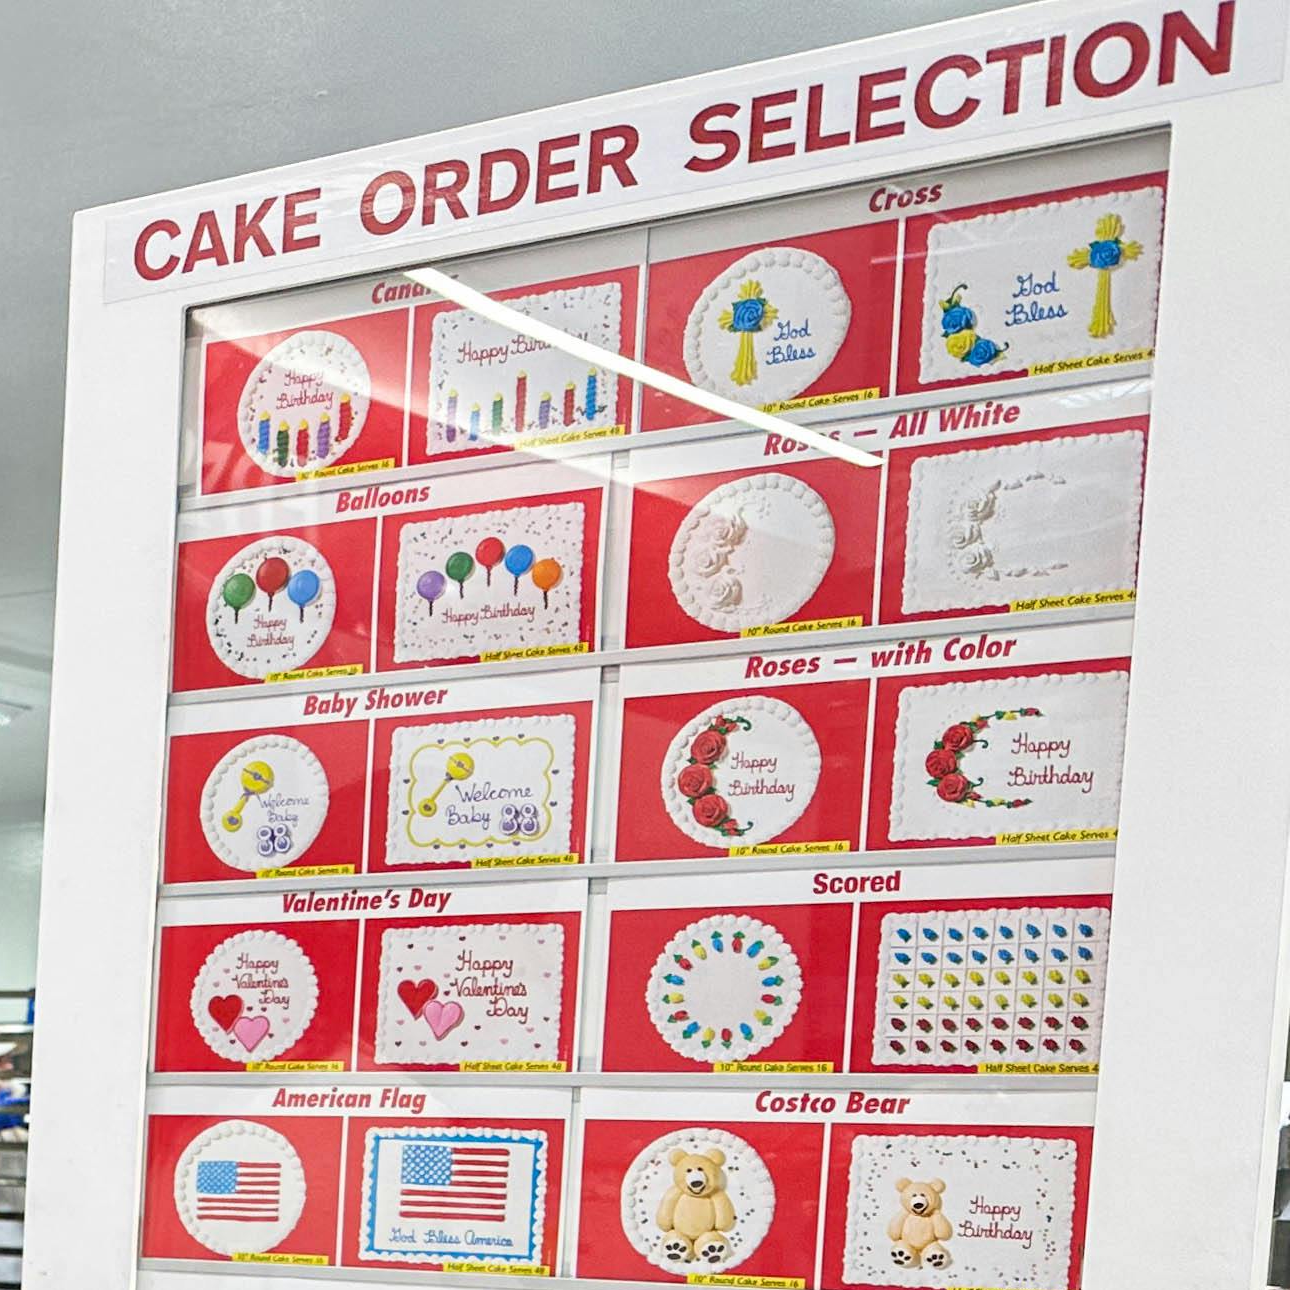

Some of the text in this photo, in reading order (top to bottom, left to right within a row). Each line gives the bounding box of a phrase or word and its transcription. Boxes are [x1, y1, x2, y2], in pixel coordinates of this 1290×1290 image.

[133, 0, 1236, 282] CAKE ORDER SELECTION
[869, 182, 943, 214] Cross
[1011, 273, 1061, 298] God
[1004, 301, 1068, 328] Bless
[772, 320, 811, 342] God
[457, 339, 509, 366] Happy
[765, 343, 816, 365] Bless
[283, 369, 324, 388] Happy
[275, 390, 333, 412] Birthday
[889, 411, 928, 438] All
[935, 402, 1021, 433] White
[335, 484, 430, 513] Balloons
[253, 615, 287, 632] Happy
[441, 604, 535, 625] Happy Birthday
[246, 632, 295, 649] Birthday
[744, 636, 1018, 679] Roses with Color
[303, 687, 448, 717] Baby Shower
[1011, 732, 1072, 759] Happy
[730, 751, 778, 773] Happy
[728, 778, 796, 801] Birthday
[1007, 765, 1094, 793] Birthday
[256, 792, 310, 809] Welcome
[455, 784, 533, 803] Welcome
[266, 810, 299, 827] Baby
[445, 805, 491, 830] Baby
[812, 871, 902, 895] Scored
[282, 888, 451, 914] Valentine’s Day
[236, 952, 280, 973] Happy
[455, 949, 514, 976] Happy
[258, 991, 290, 1009] Day
[486, 1001, 530, 1024] Day
[272, 1088, 427, 1114] American Flag
[755, 1090, 911, 1115] Costco Bear
[969, 1195, 1022, 1222] Happy
[388, 1226, 515, 1248] God Bless America
[957, 1220, 1034, 1248] Birthday
